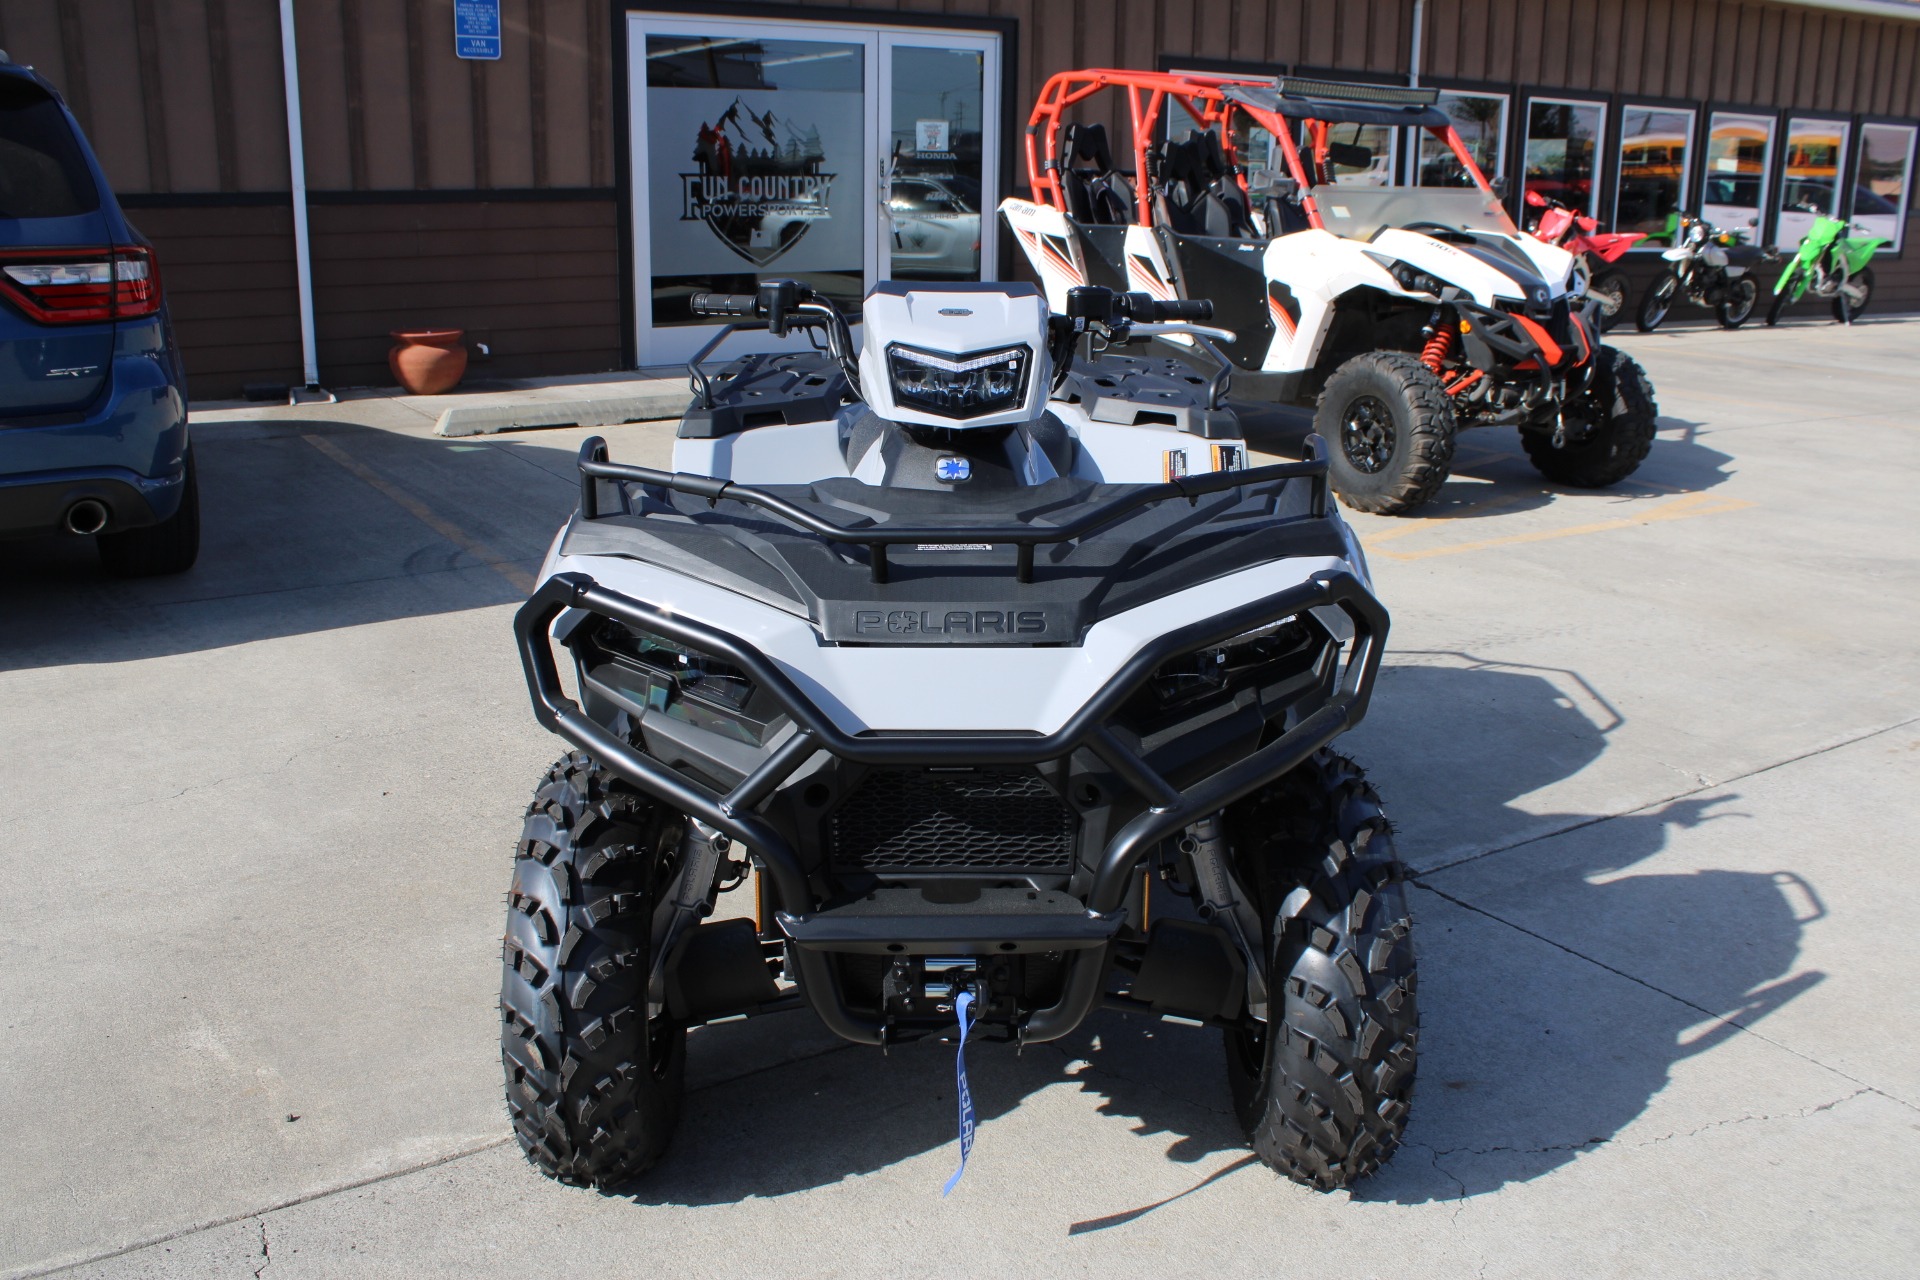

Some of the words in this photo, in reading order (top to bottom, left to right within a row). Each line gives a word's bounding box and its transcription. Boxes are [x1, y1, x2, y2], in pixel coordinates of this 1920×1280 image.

[470, 39, 486, 47] VAN
[916, 152, 957, 160] HONDA
[682, 174, 729, 218] FUN
[738, 174, 835, 217] COUNTRY
[925, 191, 948, 200] KTM
[702, 204, 823, 217] POWERSPORTS
[855, 610, 1048, 634] POLARIS
[683, 848, 703, 901] POLARIS
[1207, 848, 1228, 902] POLARIS
